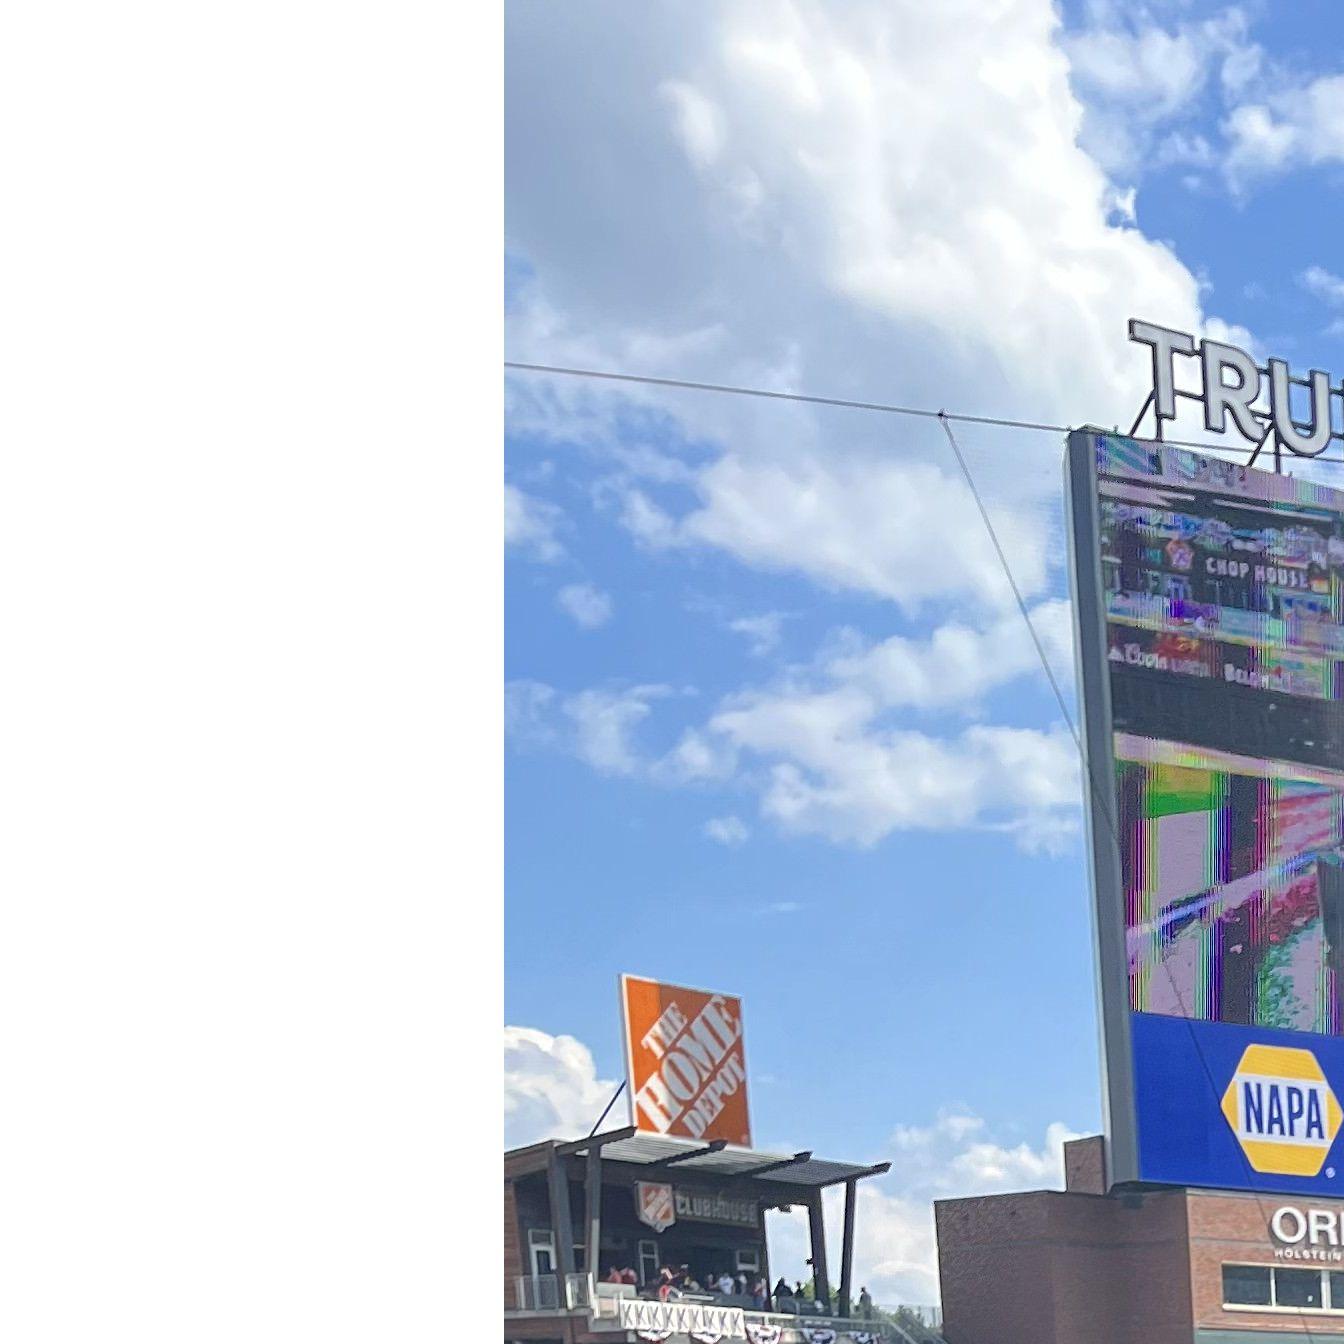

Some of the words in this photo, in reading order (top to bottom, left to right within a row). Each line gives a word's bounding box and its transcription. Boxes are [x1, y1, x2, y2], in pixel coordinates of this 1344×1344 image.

[640, 1001, 688, 1060] THE
[636, 995, 742, 1134] HOME
[682, 1051, 745, 1140] DEPOT
[1243, 1081, 1326, 1141] NAPA
[1273, 1247, 1342, 1262] HOLSTEIN
